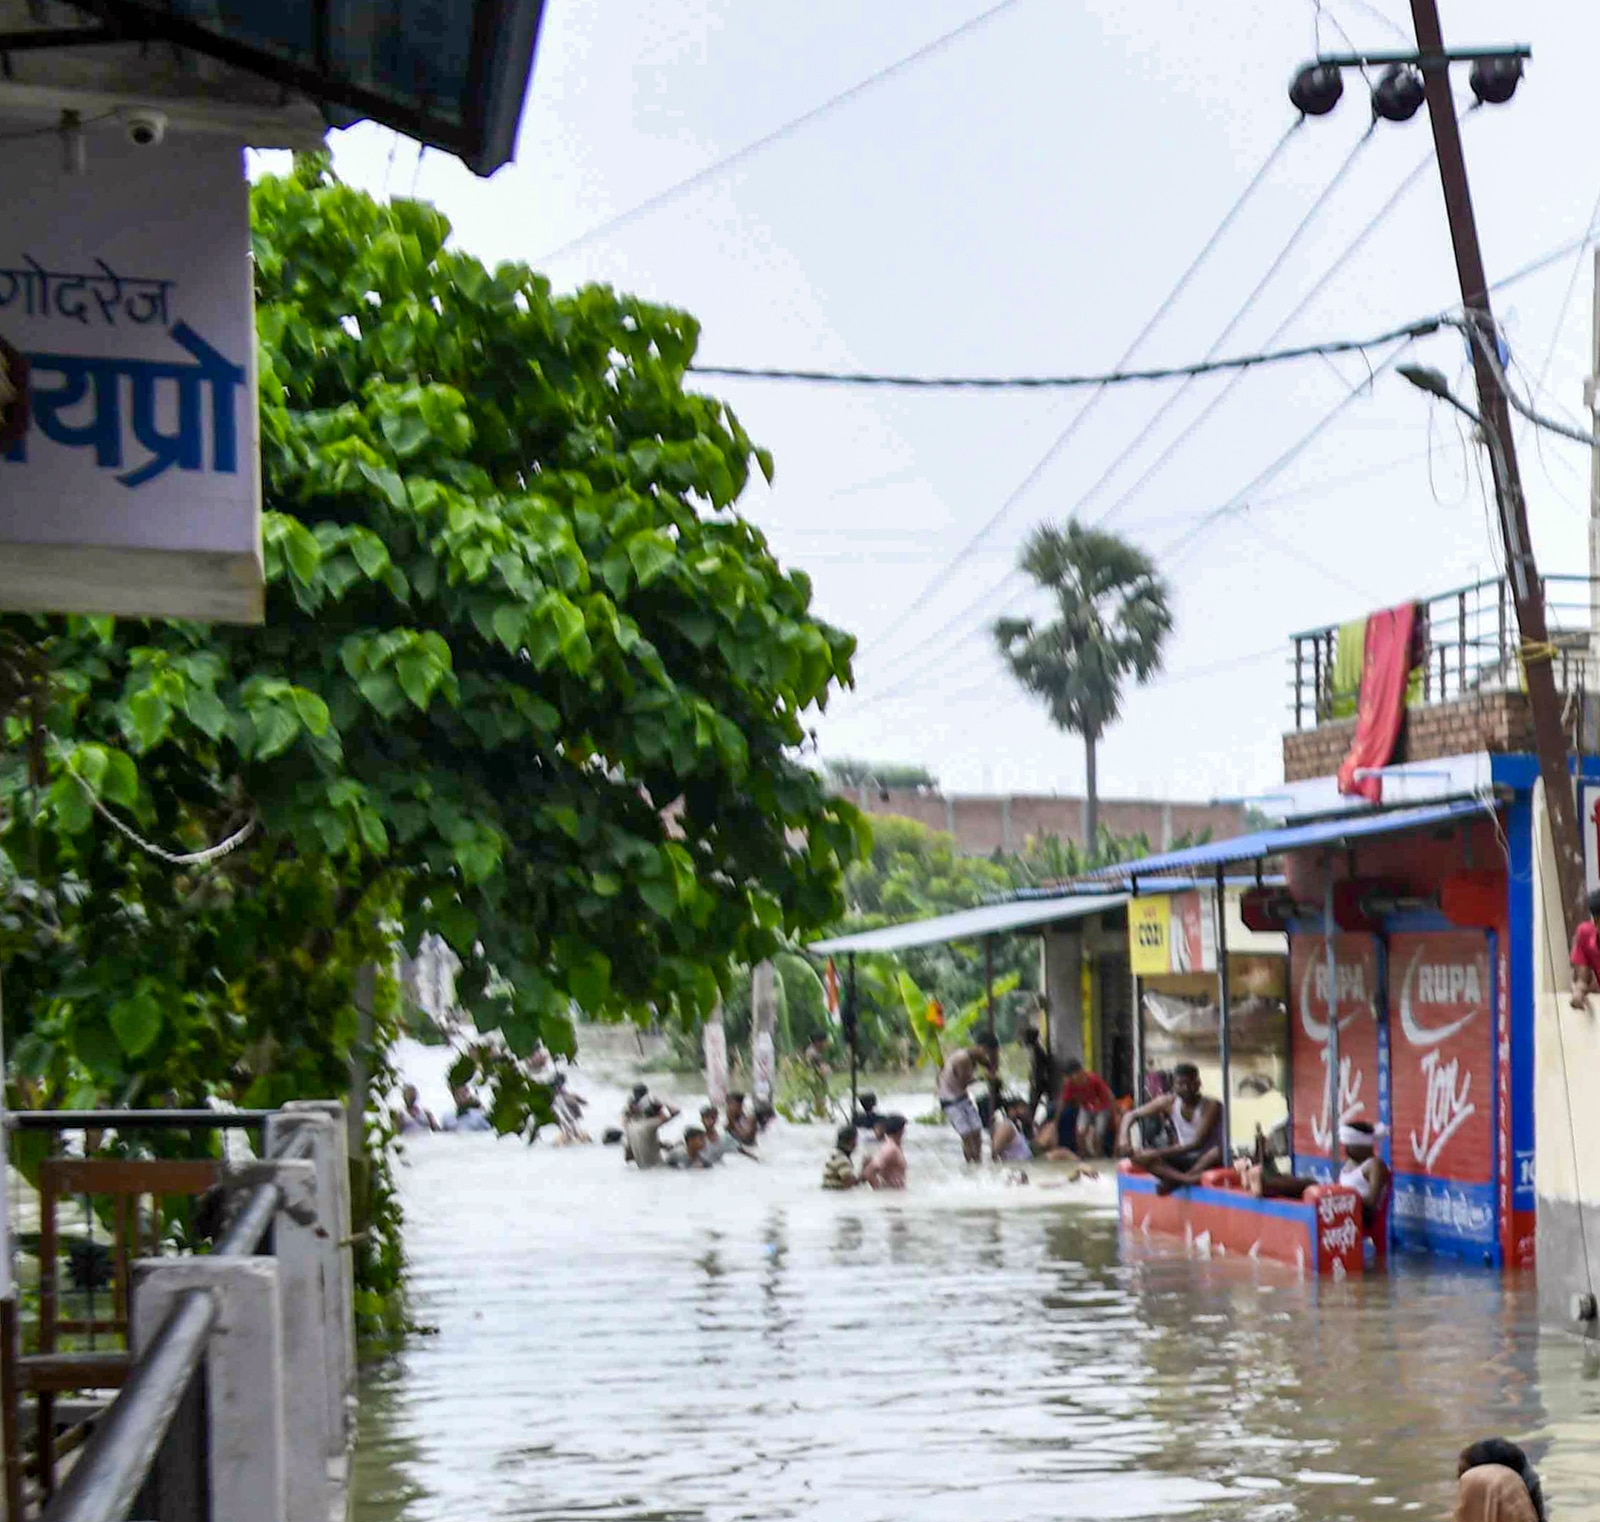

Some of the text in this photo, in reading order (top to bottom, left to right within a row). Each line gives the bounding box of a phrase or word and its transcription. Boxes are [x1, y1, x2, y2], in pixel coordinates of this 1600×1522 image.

[0, 318, 246, 488] यप्रो
[1315, 963, 1366, 1002] RPA
[1418, 963, 1482, 1004] RUPA
